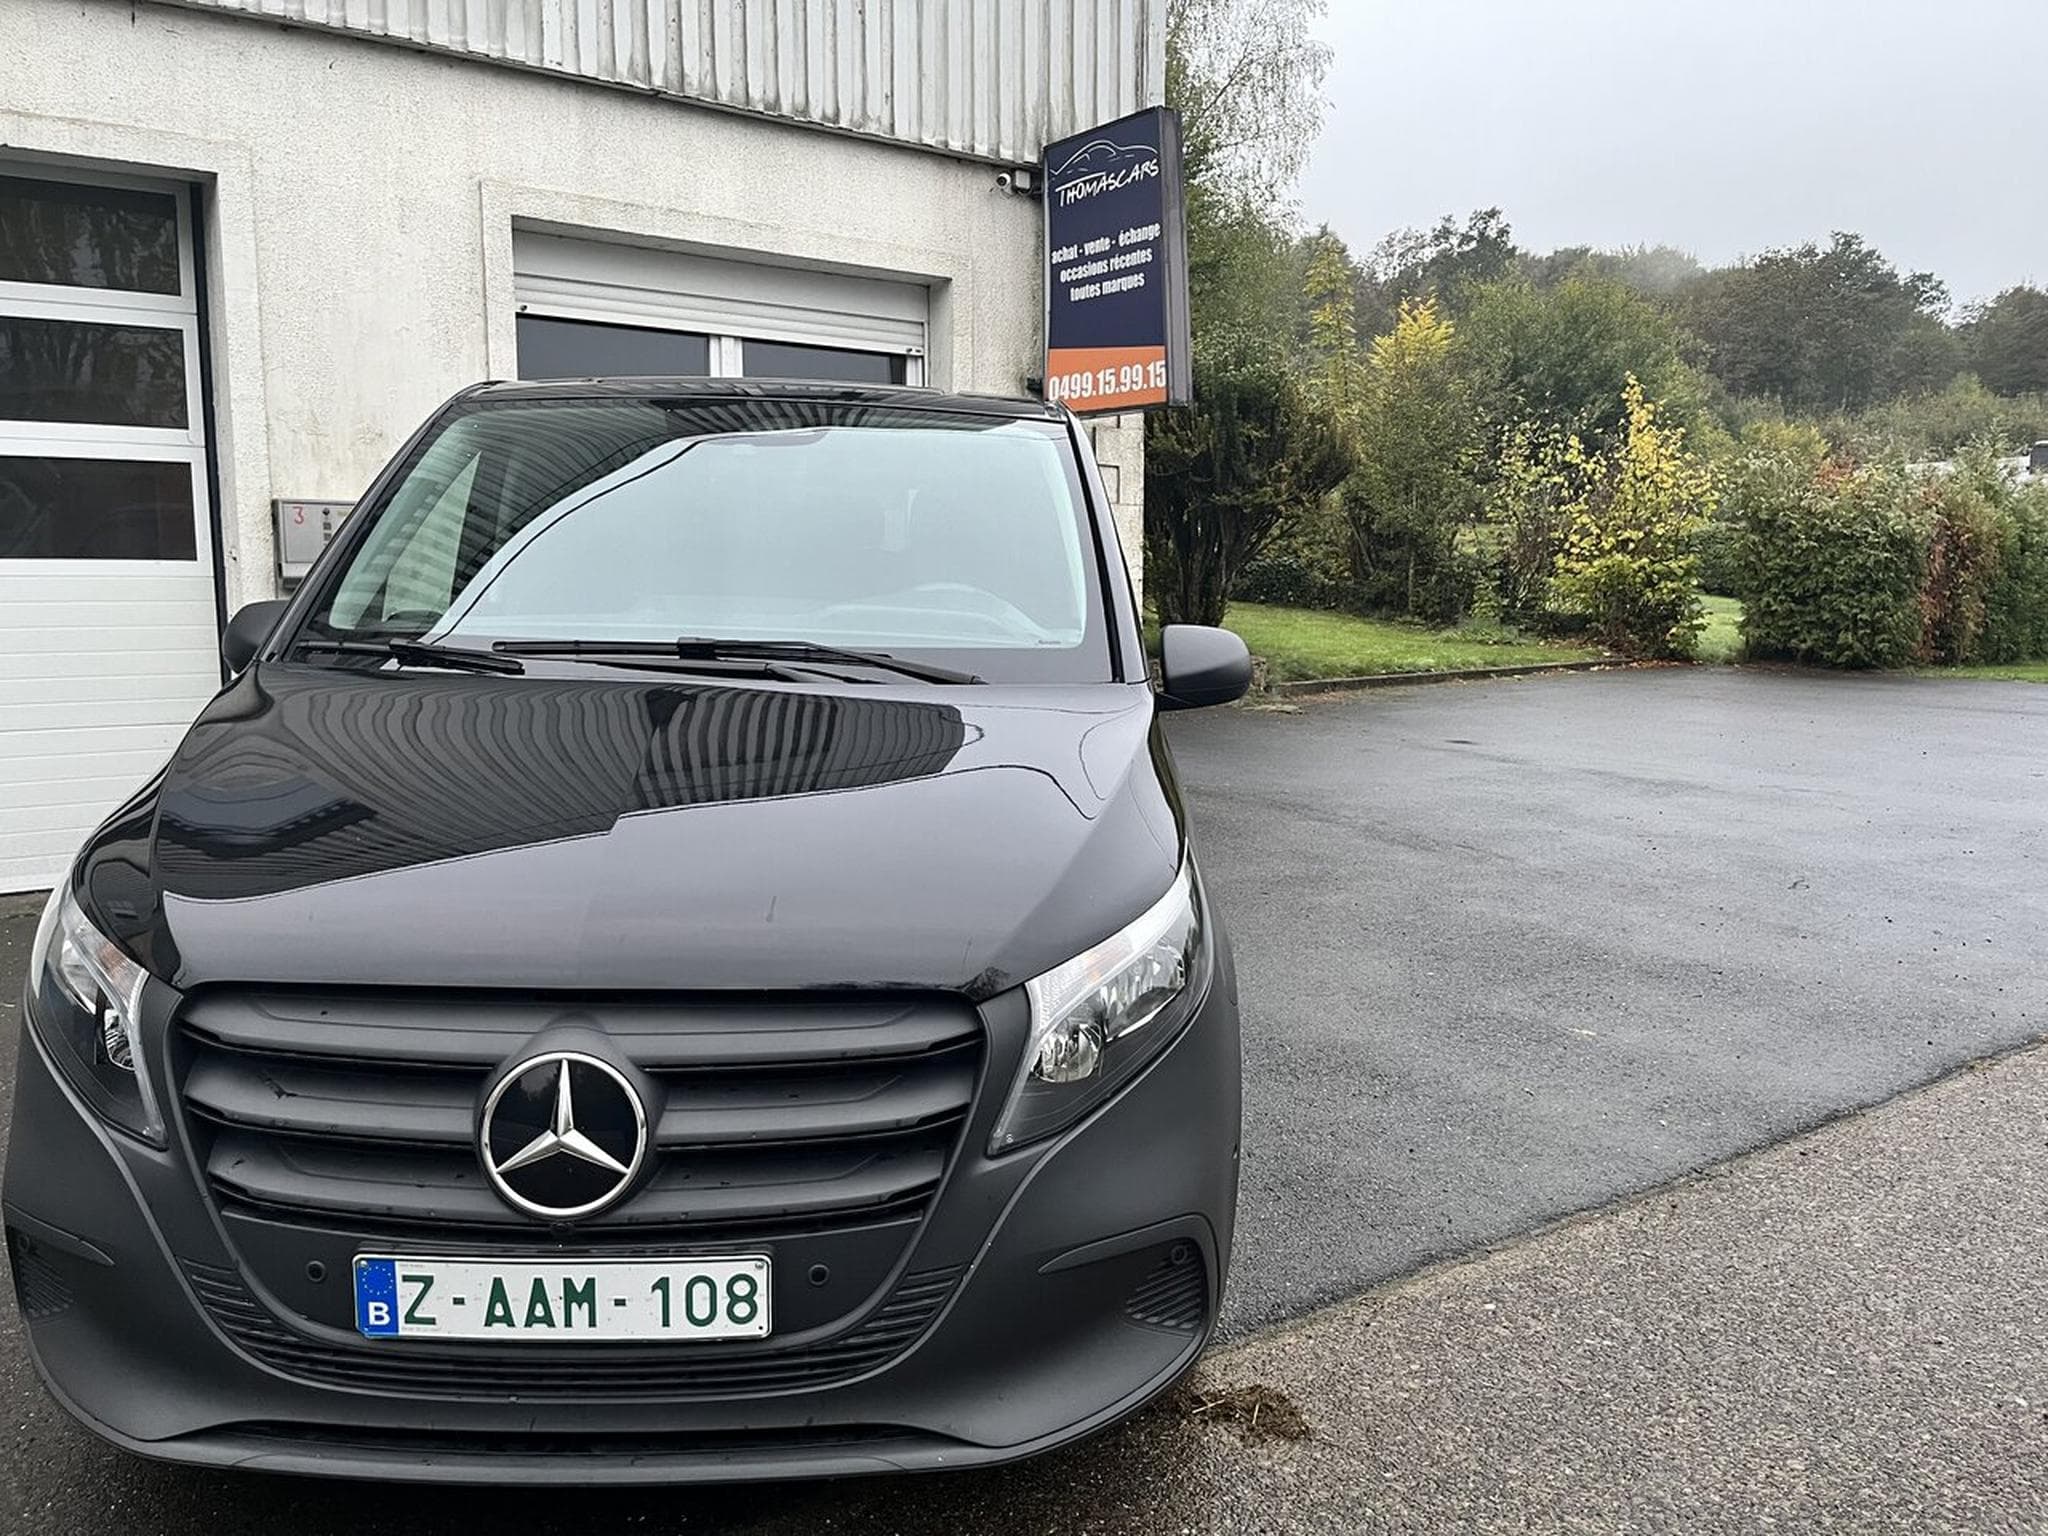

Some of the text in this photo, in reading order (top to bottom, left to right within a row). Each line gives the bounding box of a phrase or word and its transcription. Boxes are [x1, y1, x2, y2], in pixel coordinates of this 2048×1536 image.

[1051, 244, 1078, 264] achat
[1083, 237, 1111, 256] vente
[1118, 223, 1161, 247] échange
[1060, 248, 1153, 283] occasions récentes
[1070, 272, 1145, 302] toutes marques
[1048, 360, 1166, 401] 0499.15.99.15
[292, 506, 304, 524] 3
[368, 1302, 391, 1326] B
